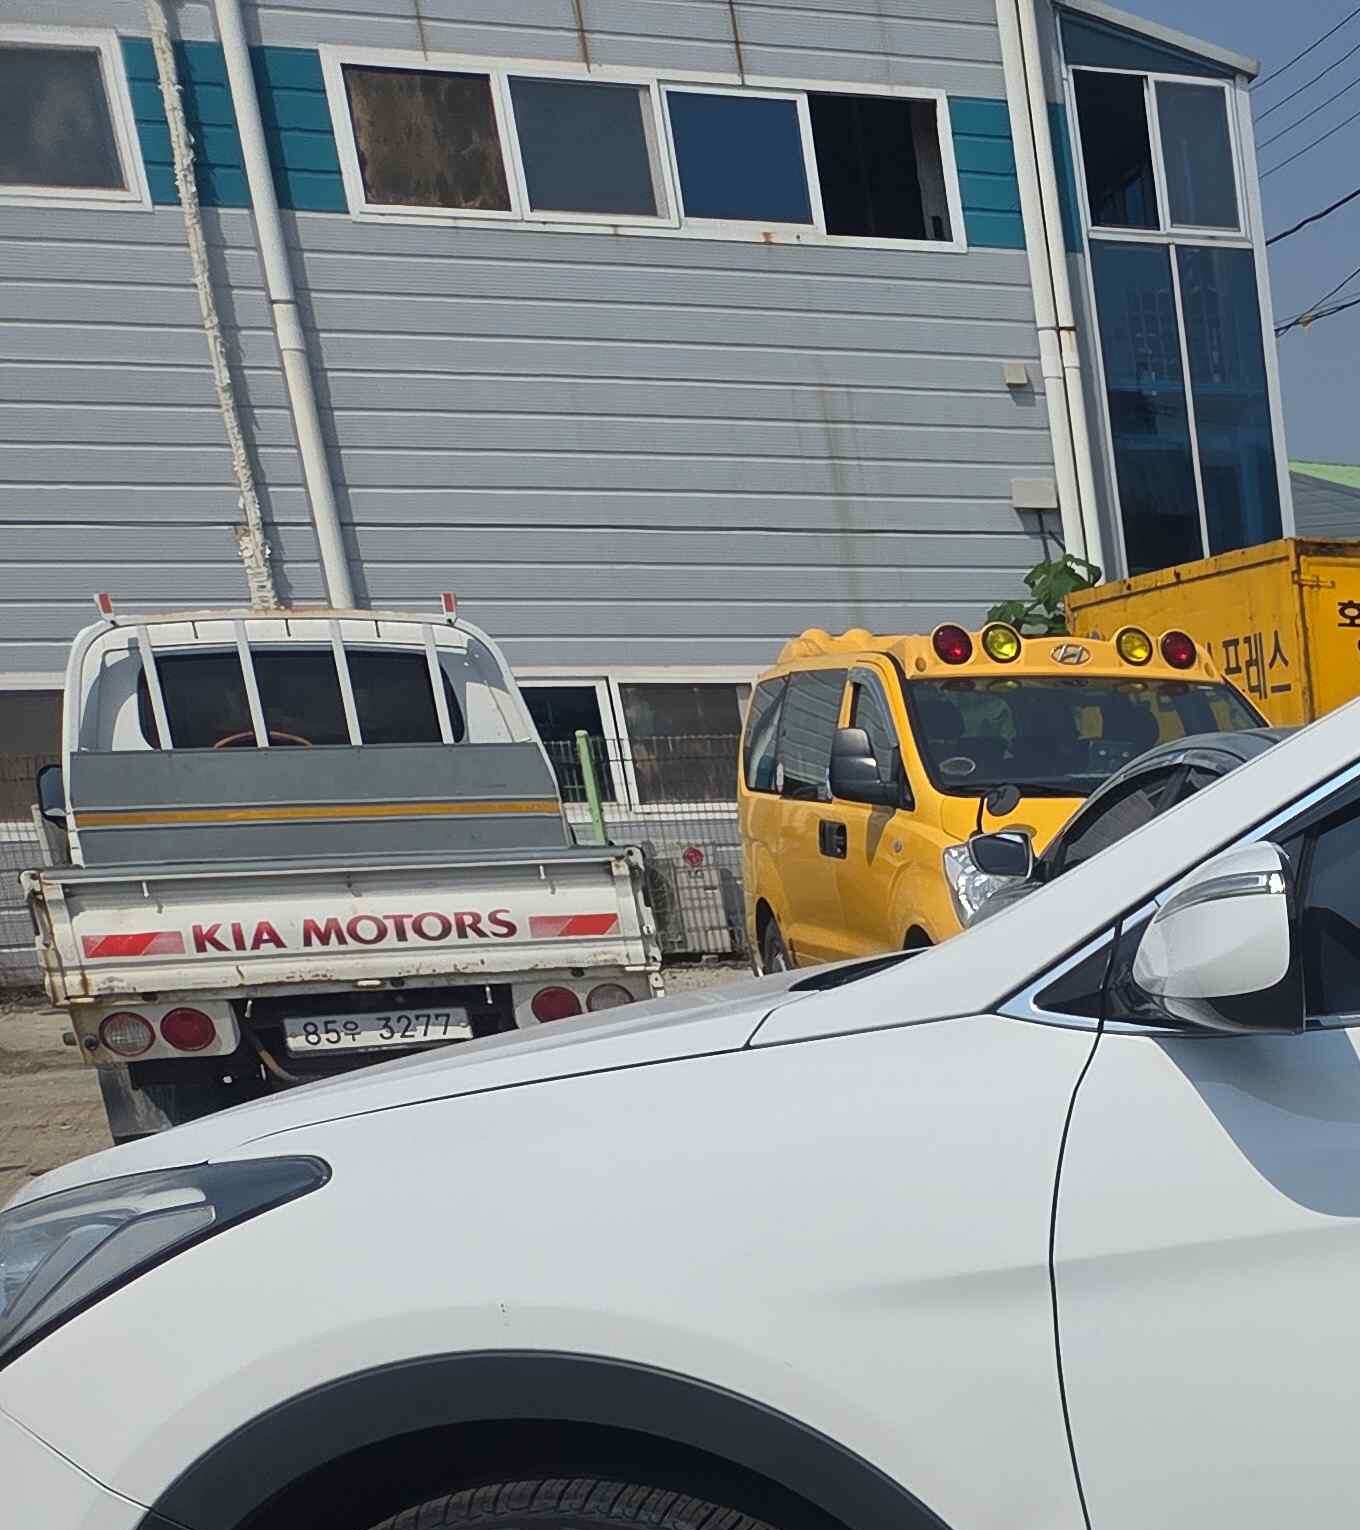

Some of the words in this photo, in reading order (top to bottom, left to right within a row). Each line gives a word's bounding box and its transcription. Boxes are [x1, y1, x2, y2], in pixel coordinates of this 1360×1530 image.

[192, 920, 289, 954] KIA
[303, 909, 518, 947] MOTORS
[376, 1013, 451, 1040] 3277
